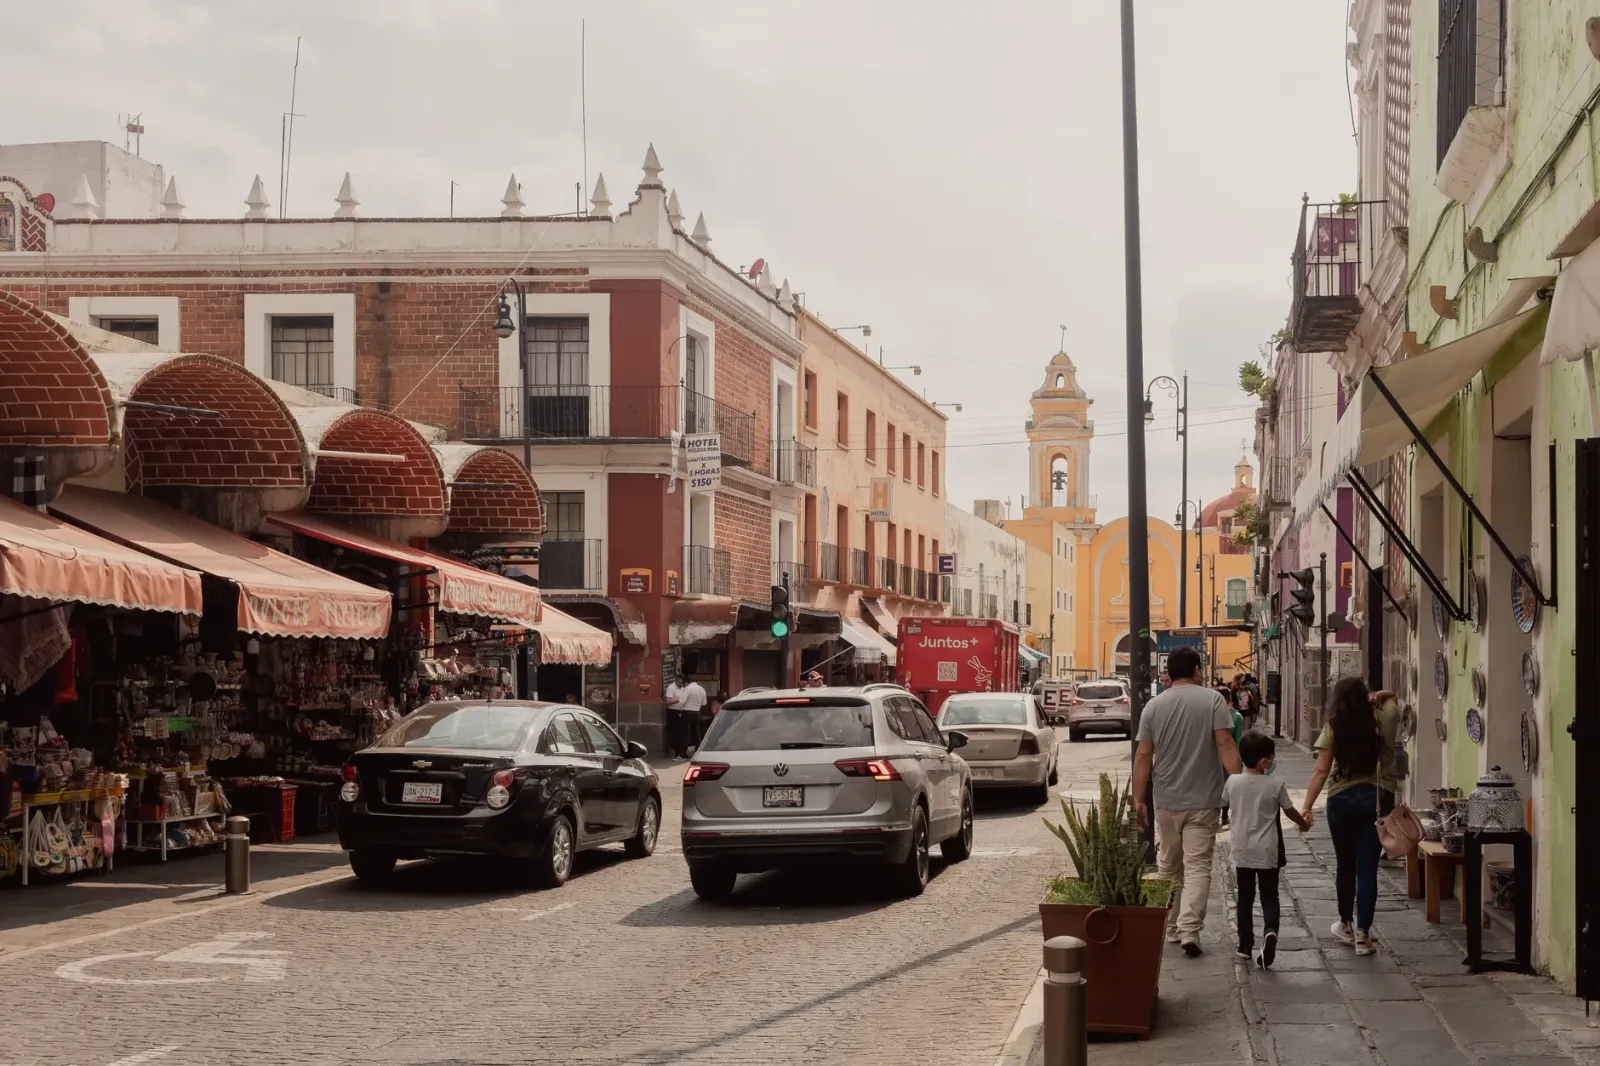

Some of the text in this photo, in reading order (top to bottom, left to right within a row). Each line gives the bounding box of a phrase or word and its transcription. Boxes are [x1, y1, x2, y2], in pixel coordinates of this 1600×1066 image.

[688, 439, 718, 448] HOTEL
[694, 468, 720, 476] HORAS
[873, 483, 888, 508] H
[938, 555, 953, 573] E
[764, 790, 802, 800] TVS-534-A
